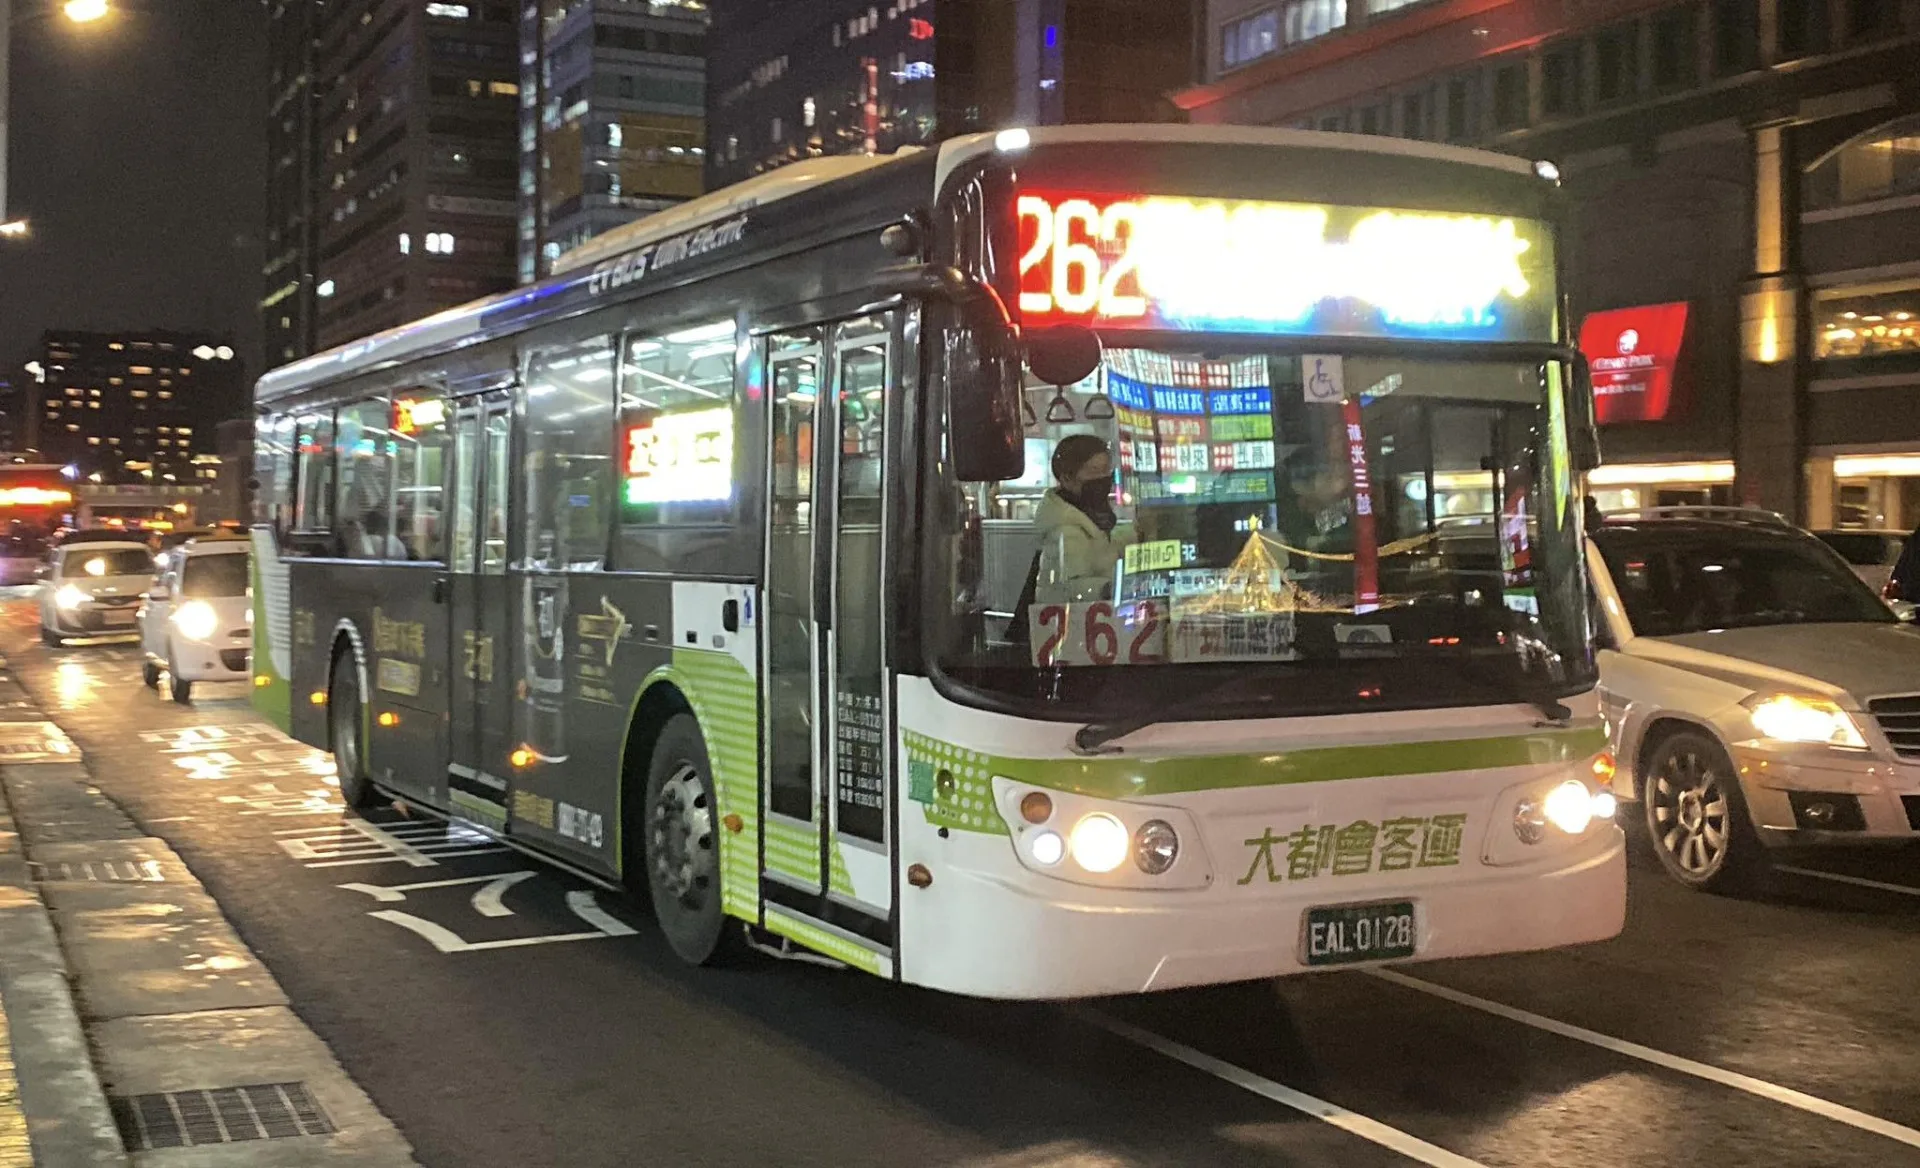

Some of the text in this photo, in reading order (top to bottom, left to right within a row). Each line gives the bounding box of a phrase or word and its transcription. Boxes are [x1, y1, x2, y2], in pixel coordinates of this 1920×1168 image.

[1018, 195, 1146, 316] 262
[1036, 600, 1162, 666] 262
[1236, 813, 1468, 886] 大都會客運
